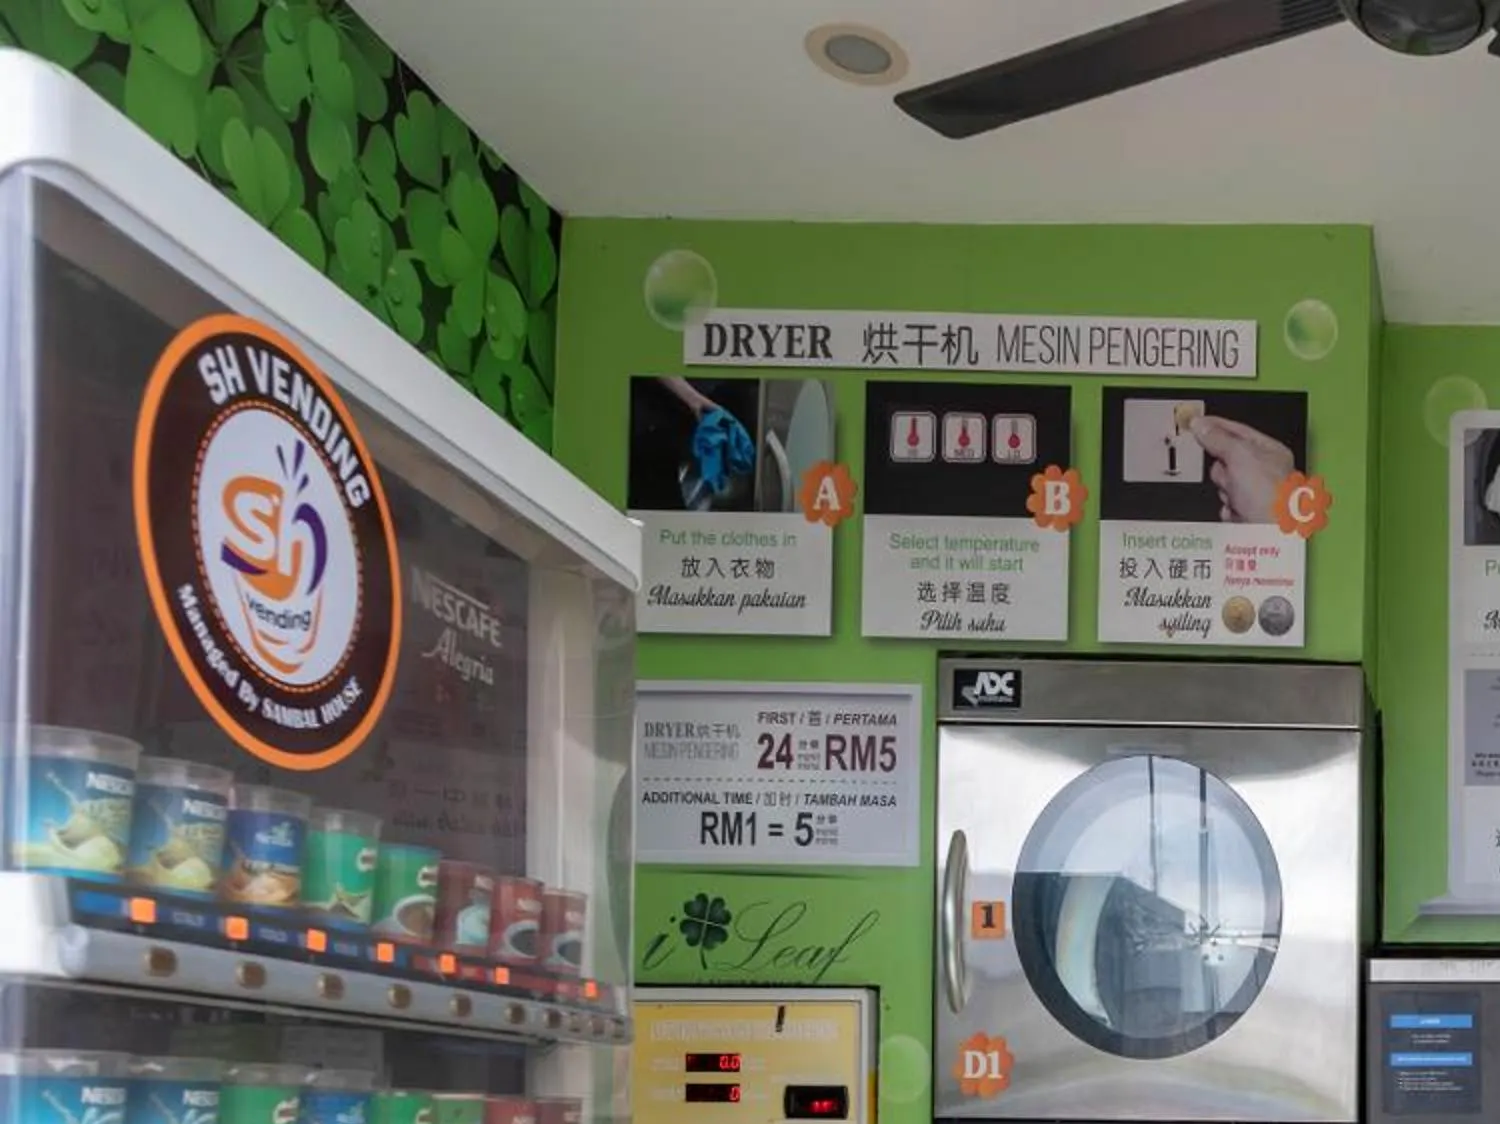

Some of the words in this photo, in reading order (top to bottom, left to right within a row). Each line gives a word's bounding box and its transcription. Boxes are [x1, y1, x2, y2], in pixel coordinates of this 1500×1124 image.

[704, 323, 833, 358] DRYER
[862, 322, 979, 365] 烘干机
[997, 324, 1081, 365] MESIN
[1089, 326, 1240, 369] PENGERING
[199, 346, 246, 404] SH
[246, 345, 370, 508] VENDING
[813, 476, 841, 511] A
[1045, 481, 1071, 515] B
[1288, 487, 1316, 523] C
[660, 530, 695, 547] Put
[699, 530, 719, 547] the
[722, 530, 779, 548] clothes
[783, 532, 797, 548] in
[890, 533, 938, 550] Select
[944, 534, 1040, 554] temperature
[1122, 533, 1168, 550] Insert
[1171, 534, 1213, 550] coins
[681, 557, 775, 579] 放入衣物
[911, 556, 940, 570] and
[945, 556, 955, 570] it
[959, 556, 984, 570] will
[987, 557, 1024, 572] start
[1119, 556, 1212, 580] 投入硬币
[917, 581, 1011, 605] 选择温度
[246, 592, 312, 631] vending
[177, 583, 238, 688] Managed
[238, 682, 261, 713] By
[644, 721, 696, 739] DRYER
[757, 711, 796, 726] FIRST
[833, 713, 898, 726] PERTAMA
[757, 733, 794, 771] 24
[825, 734, 898, 773] RM5
[642, 790, 720, 806] ADDITIONAL
[724, 793, 753, 806] TIME
[804, 793, 858, 807] TAMBAH
[860, 794, 897, 808] MASA
[700, 811, 757, 846] RM1
[767, 823, 783, 837] =
[794, 812, 815, 847] 5
[981, 905, 996, 929] 1
[713, 900, 880, 983] Leaf
[964, 1051, 1002, 1080] D1
